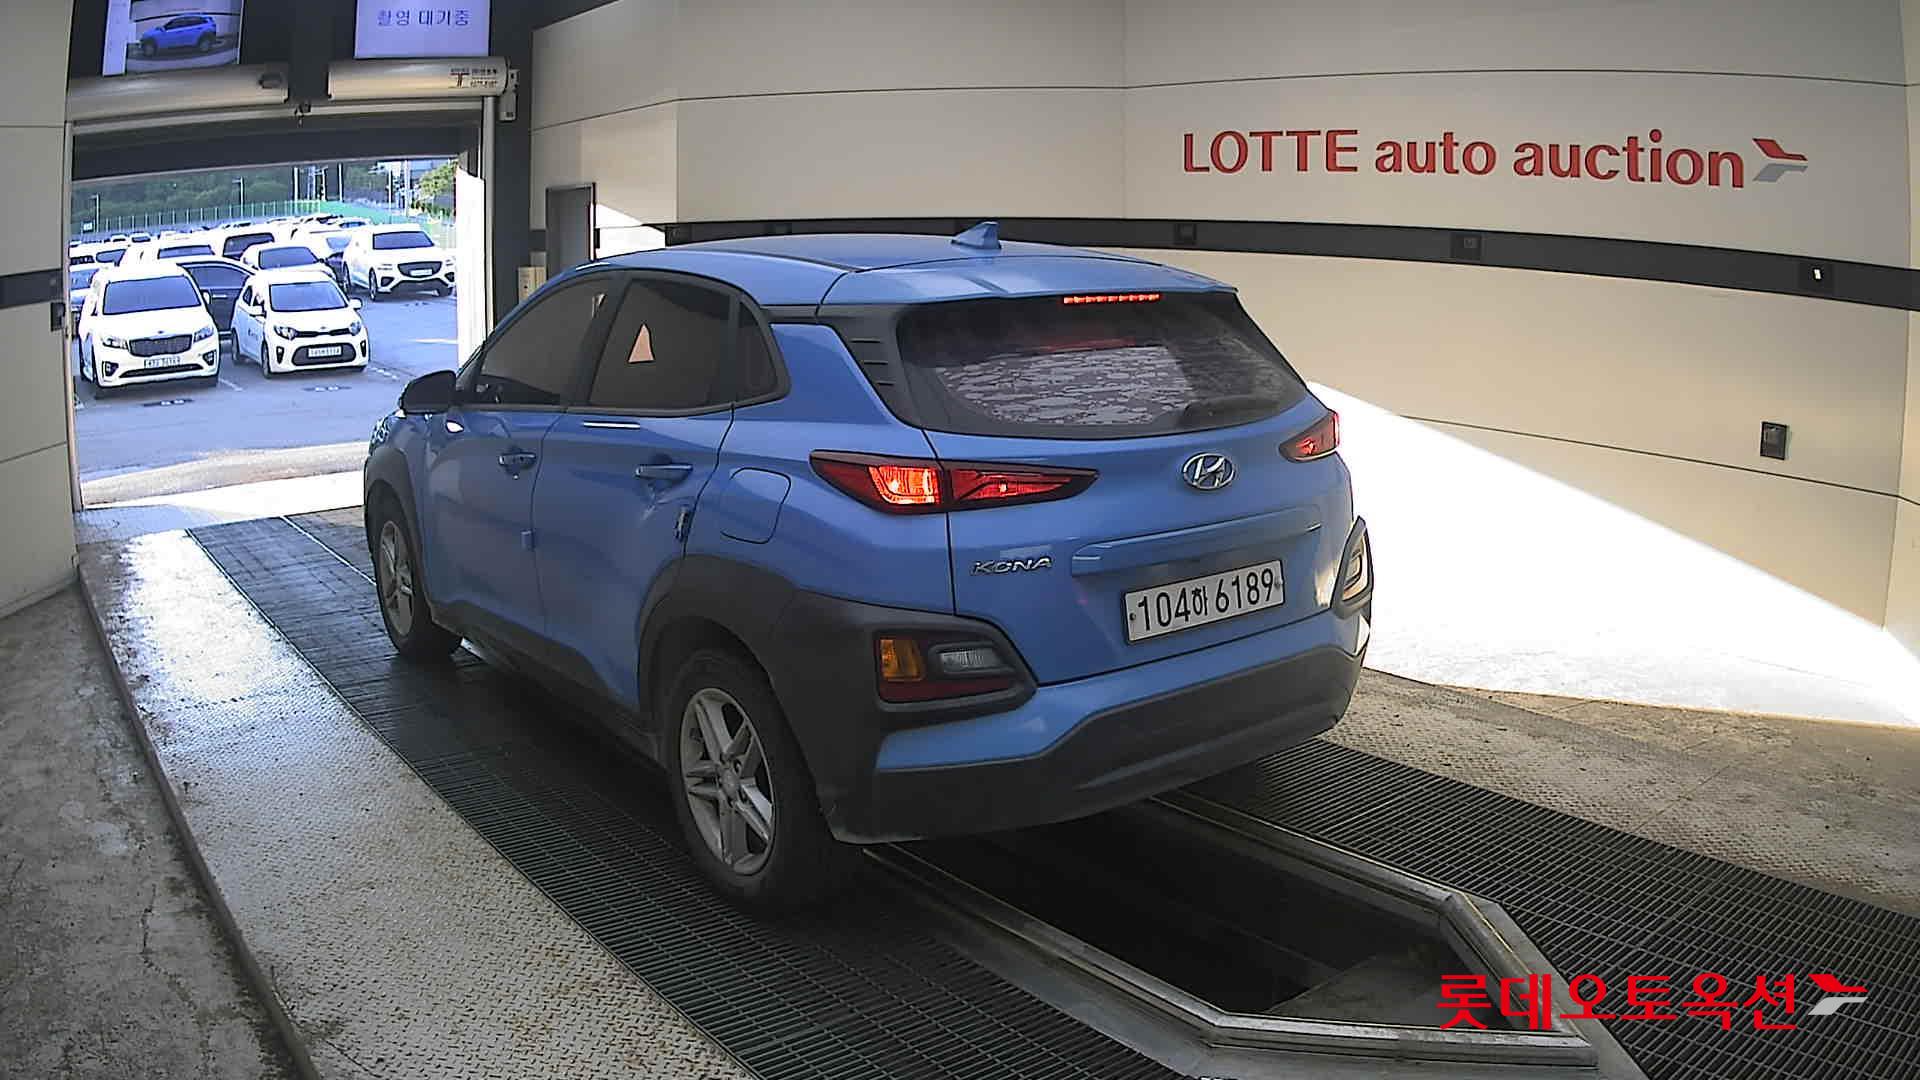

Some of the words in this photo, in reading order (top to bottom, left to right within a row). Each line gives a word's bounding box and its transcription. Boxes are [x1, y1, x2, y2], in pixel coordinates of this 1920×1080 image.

[418, 9, 469, 26] 대기중
[1184, 129, 1357, 174] LOTTE
[1376, 131, 1497, 175] auto
[1513, 129, 1744, 188] auction
[971, 556, 1052, 574] KONA
[1137, 585, 1209, 632] 104하
[1215, 569, 1275, 614] 6189
